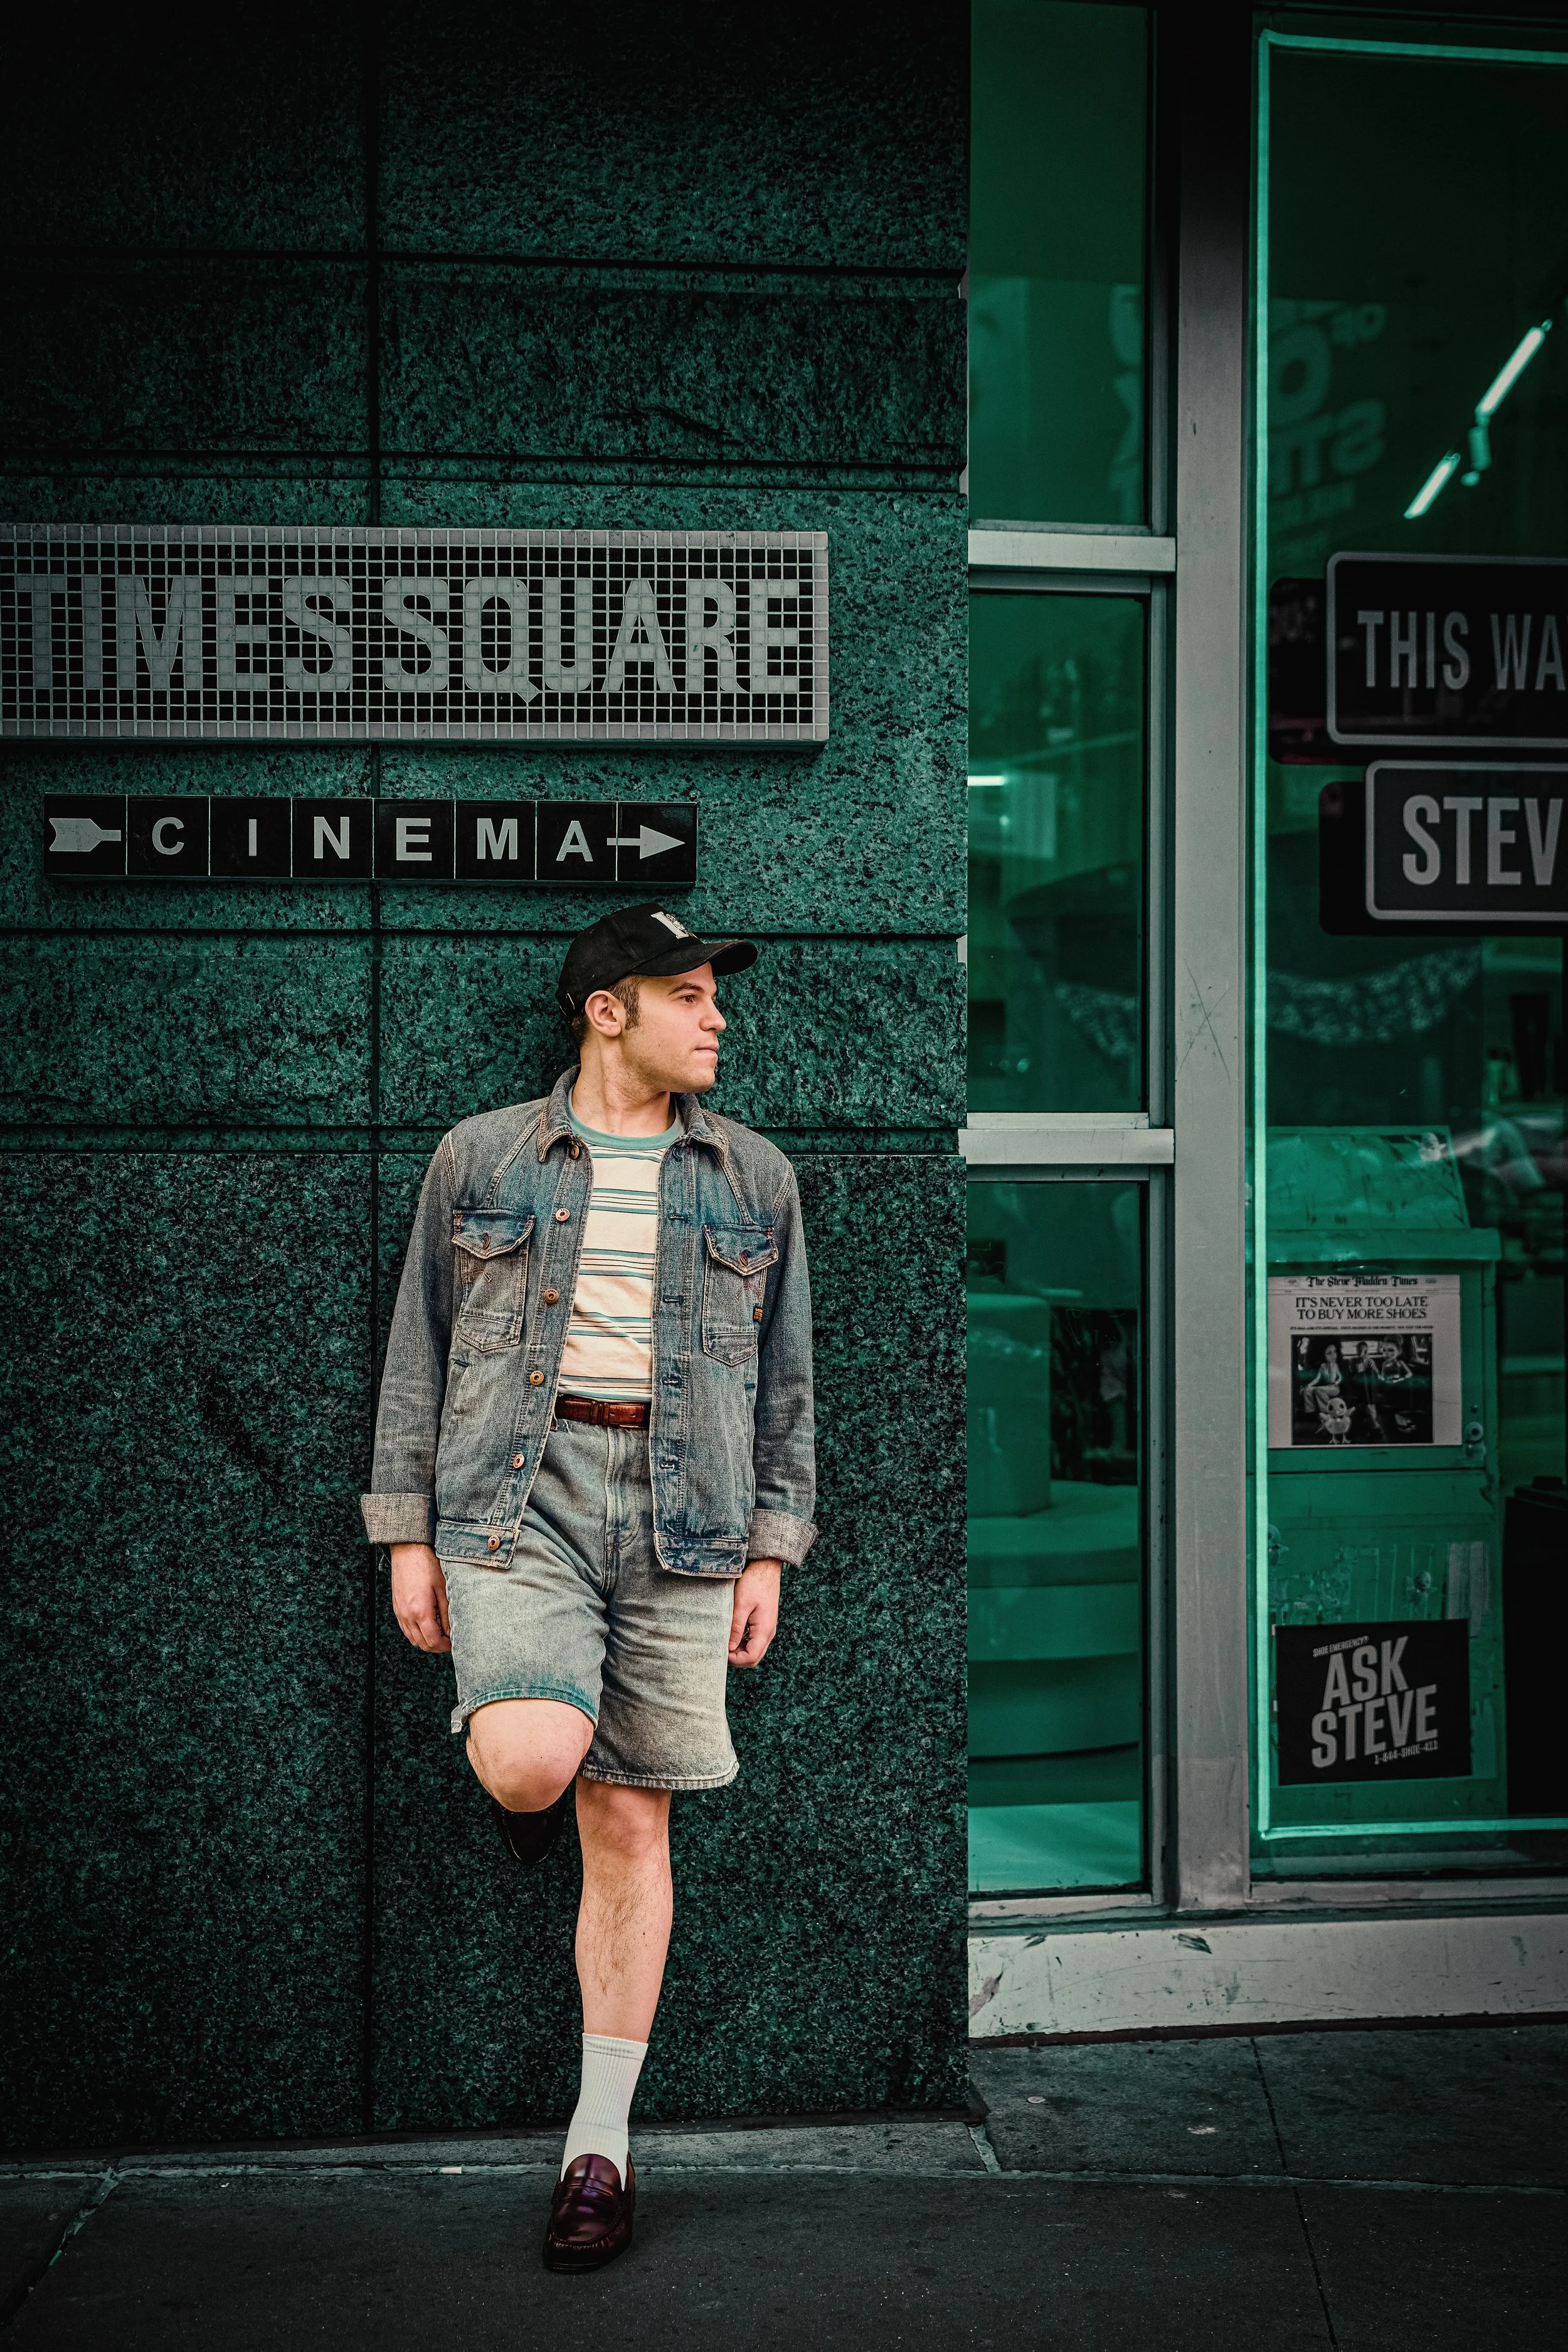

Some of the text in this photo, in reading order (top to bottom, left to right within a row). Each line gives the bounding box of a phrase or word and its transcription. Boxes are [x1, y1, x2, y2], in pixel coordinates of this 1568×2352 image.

[16, 574, 798, 703] TIMES SQUARE
[1357, 610, 1568, 691] THIS WA
[152, 816, 594, 862] CINEMA
[1296, 1296, 1428, 1308] IT'S NEVER TOO LATE
[1306, 1276, 1325, 1287] The
[1391, 1275, 1418, 1287] Times
[1297, 1308, 1427, 1320] TO BUY MORE SHOES
[1322, 1635, 1409, 1711] ASK
[1311, 1683, 1439, 1769] STEVE
